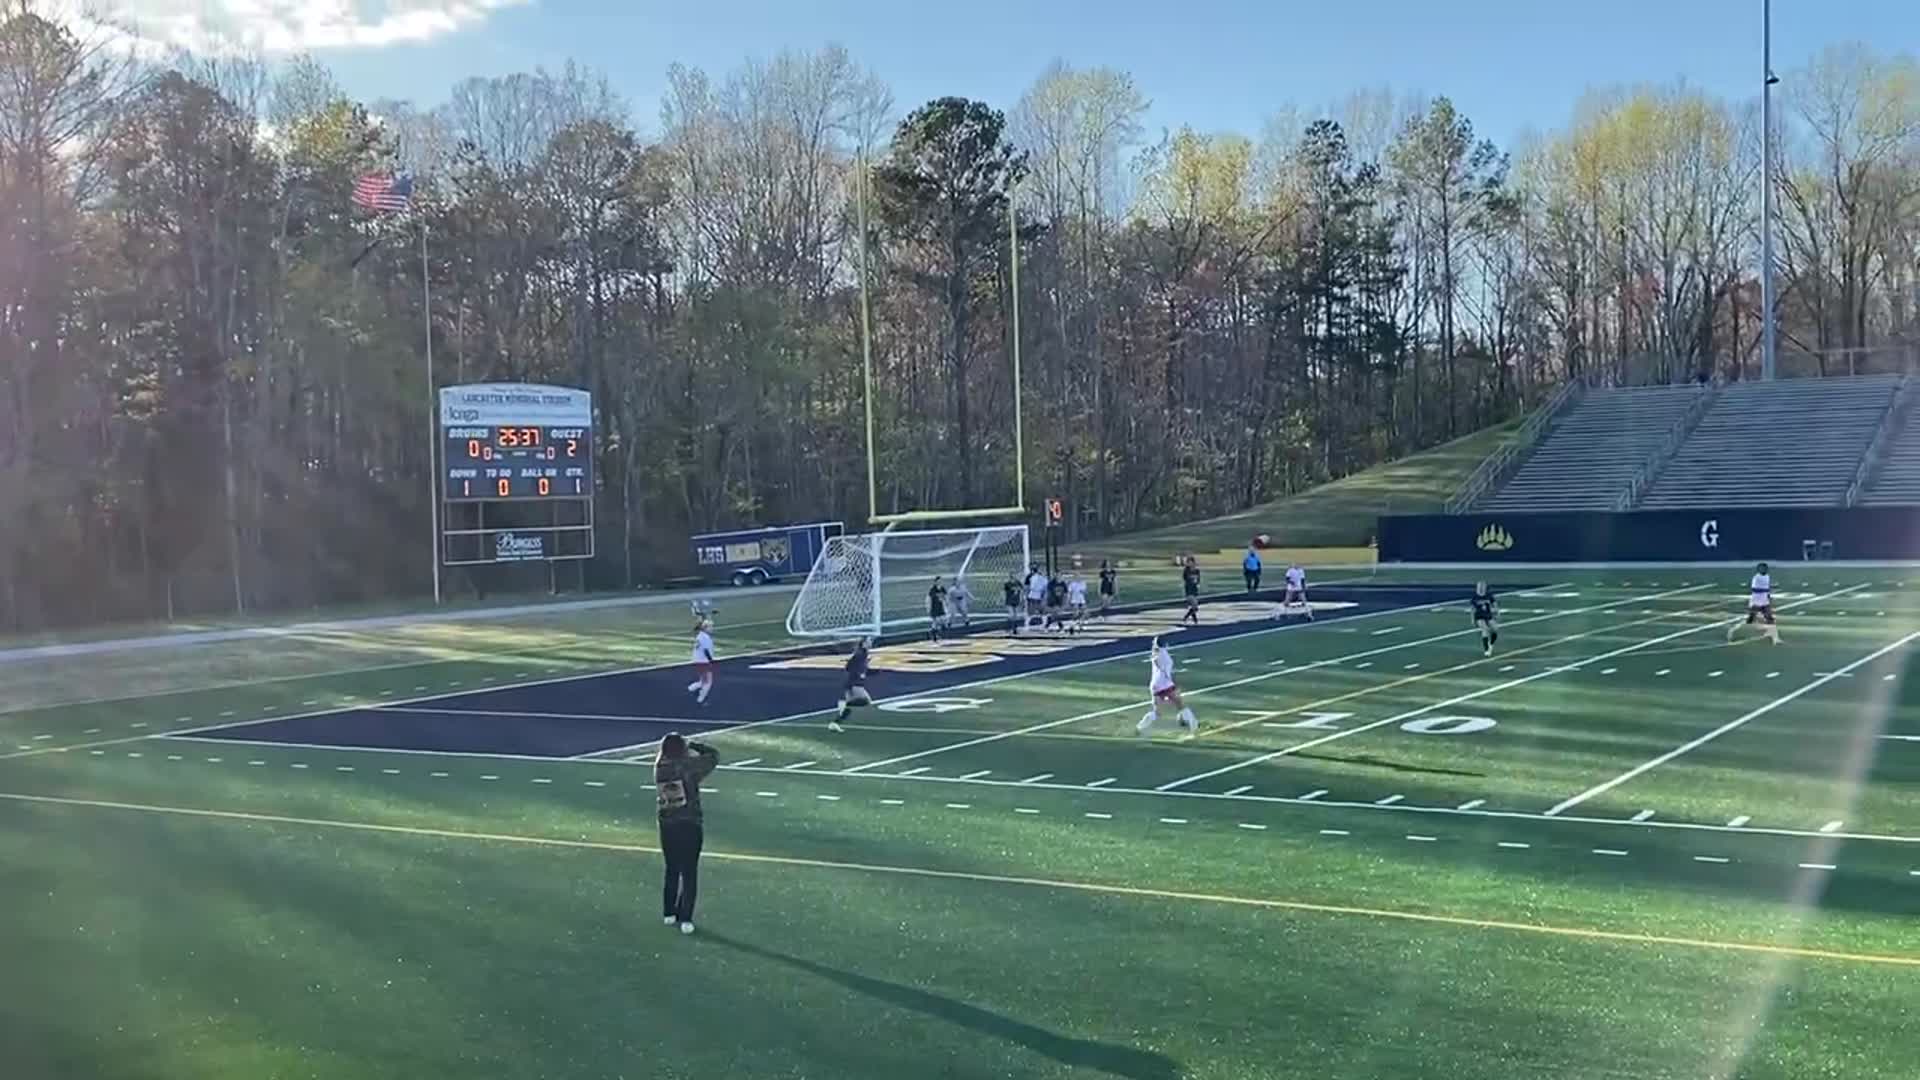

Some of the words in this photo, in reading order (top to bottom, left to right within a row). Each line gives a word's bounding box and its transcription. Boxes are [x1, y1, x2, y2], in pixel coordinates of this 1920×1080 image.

[449, 428, 488, 438] BRUINS
[499, 429, 540, 446] 25:37
[551, 429, 583, 438] GUEST
[469, 440, 479, 457] 0
[483, 447, 492, 460] 0
[547, 447, 555, 460] 0
[567, 440, 577, 457] 2
[450, 469, 477, 478] DOWN
[485, 469, 497, 478] TO
[499, 469, 512, 478] GO
[521, 468, 542, 477] BALL
[544, 468, 557, 477] ON
[464, 479, 470, 496] 1
[499, 479, 509, 496] 0
[538, 478, 549, 495] 0
[575, 478, 581, 493] 1
[1701, 520, 1719, 547] G
